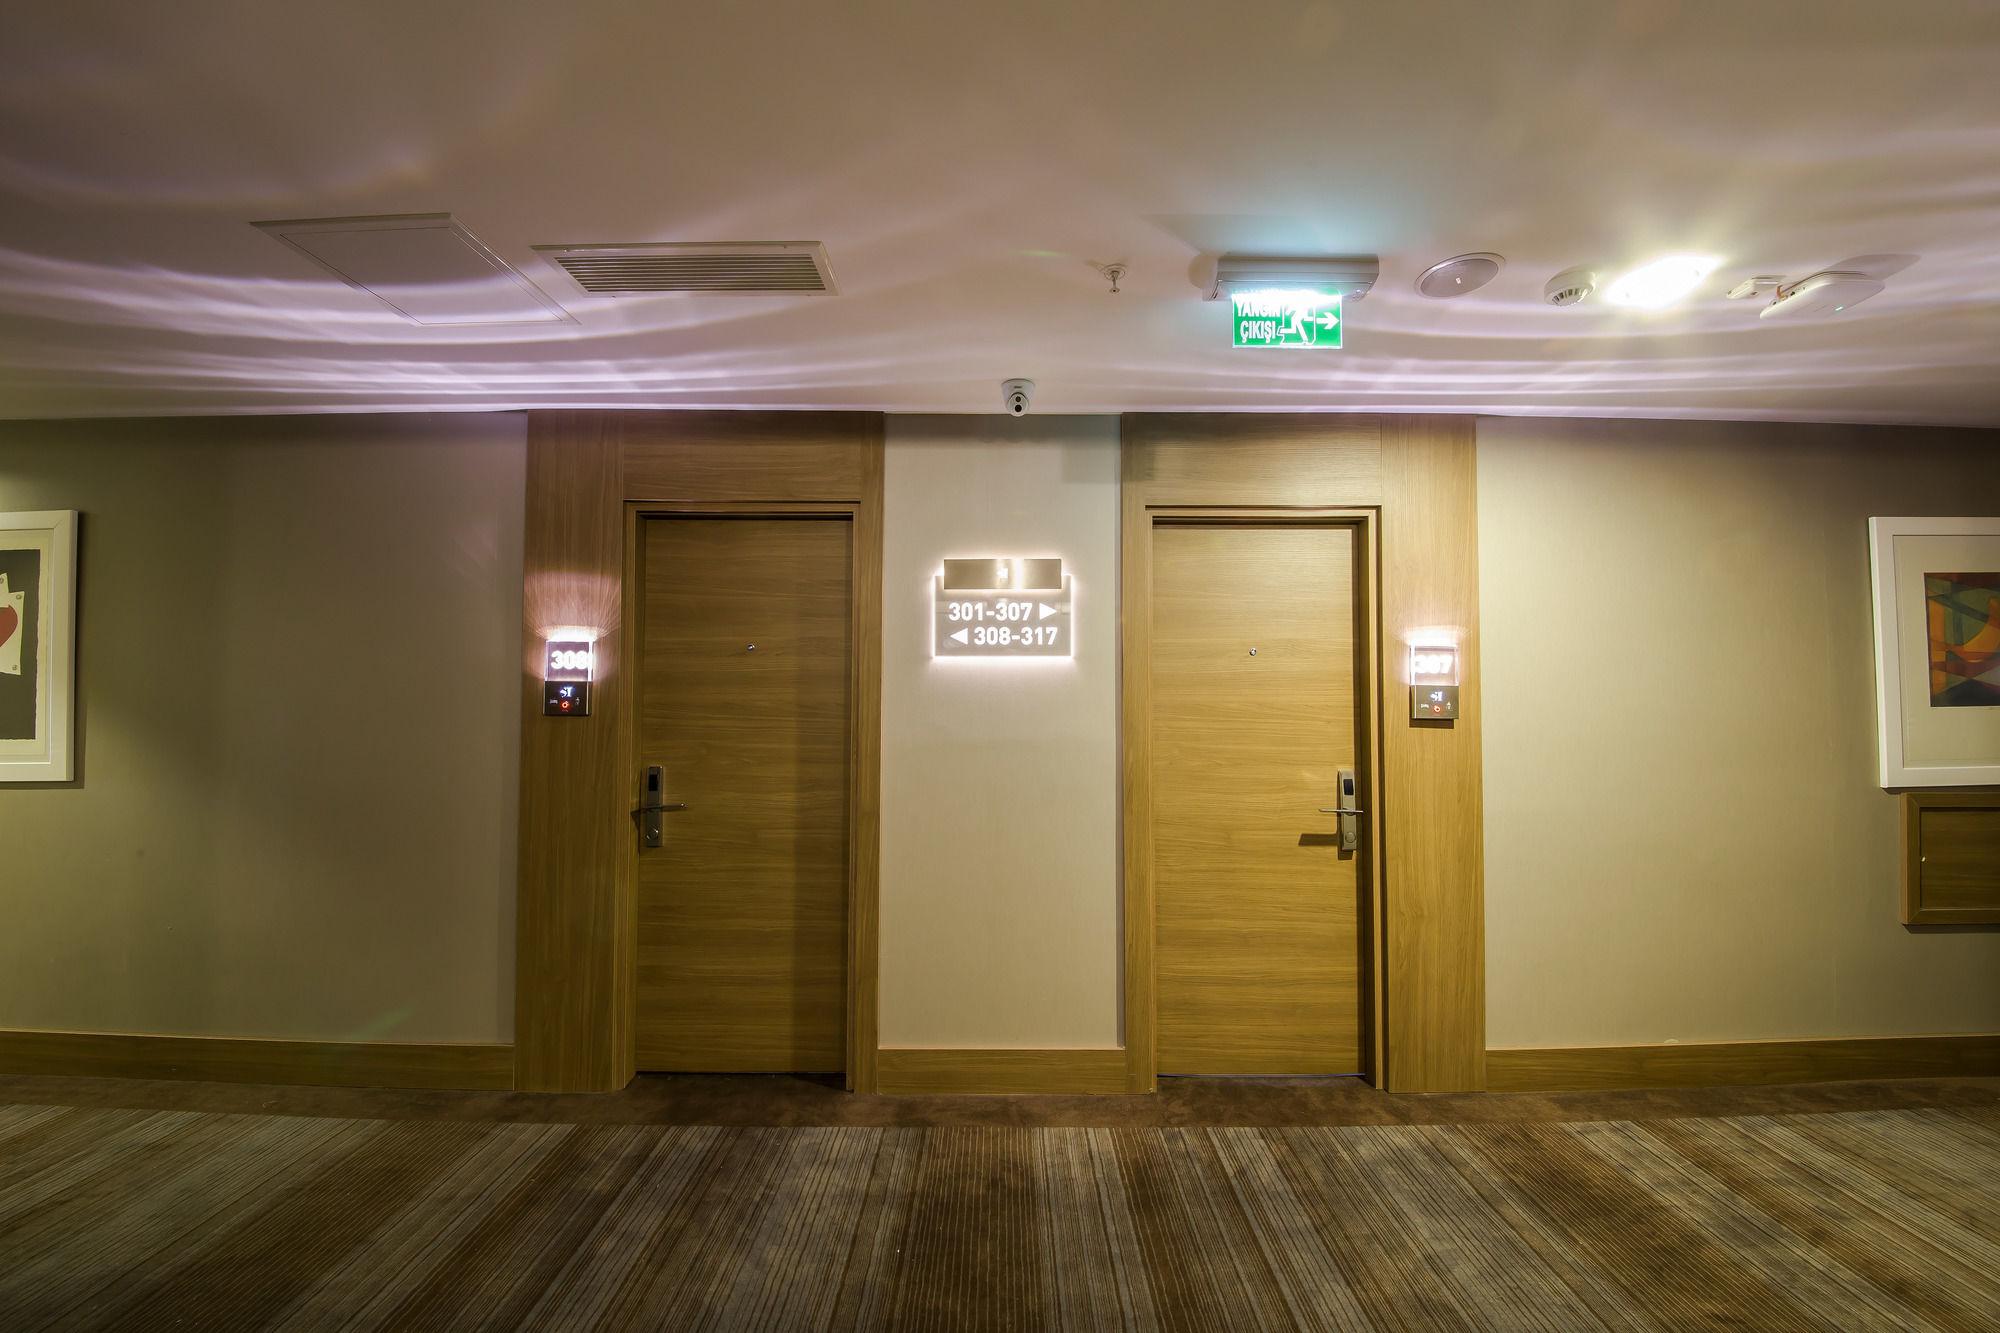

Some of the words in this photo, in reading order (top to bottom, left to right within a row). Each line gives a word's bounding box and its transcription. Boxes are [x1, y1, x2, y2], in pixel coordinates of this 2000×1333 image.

[1240, 321, 1276, 343] ÇIKIŞI
[949, 602, 1033, 620] 301-307
[974, 627, 1058, 645] 308-317
